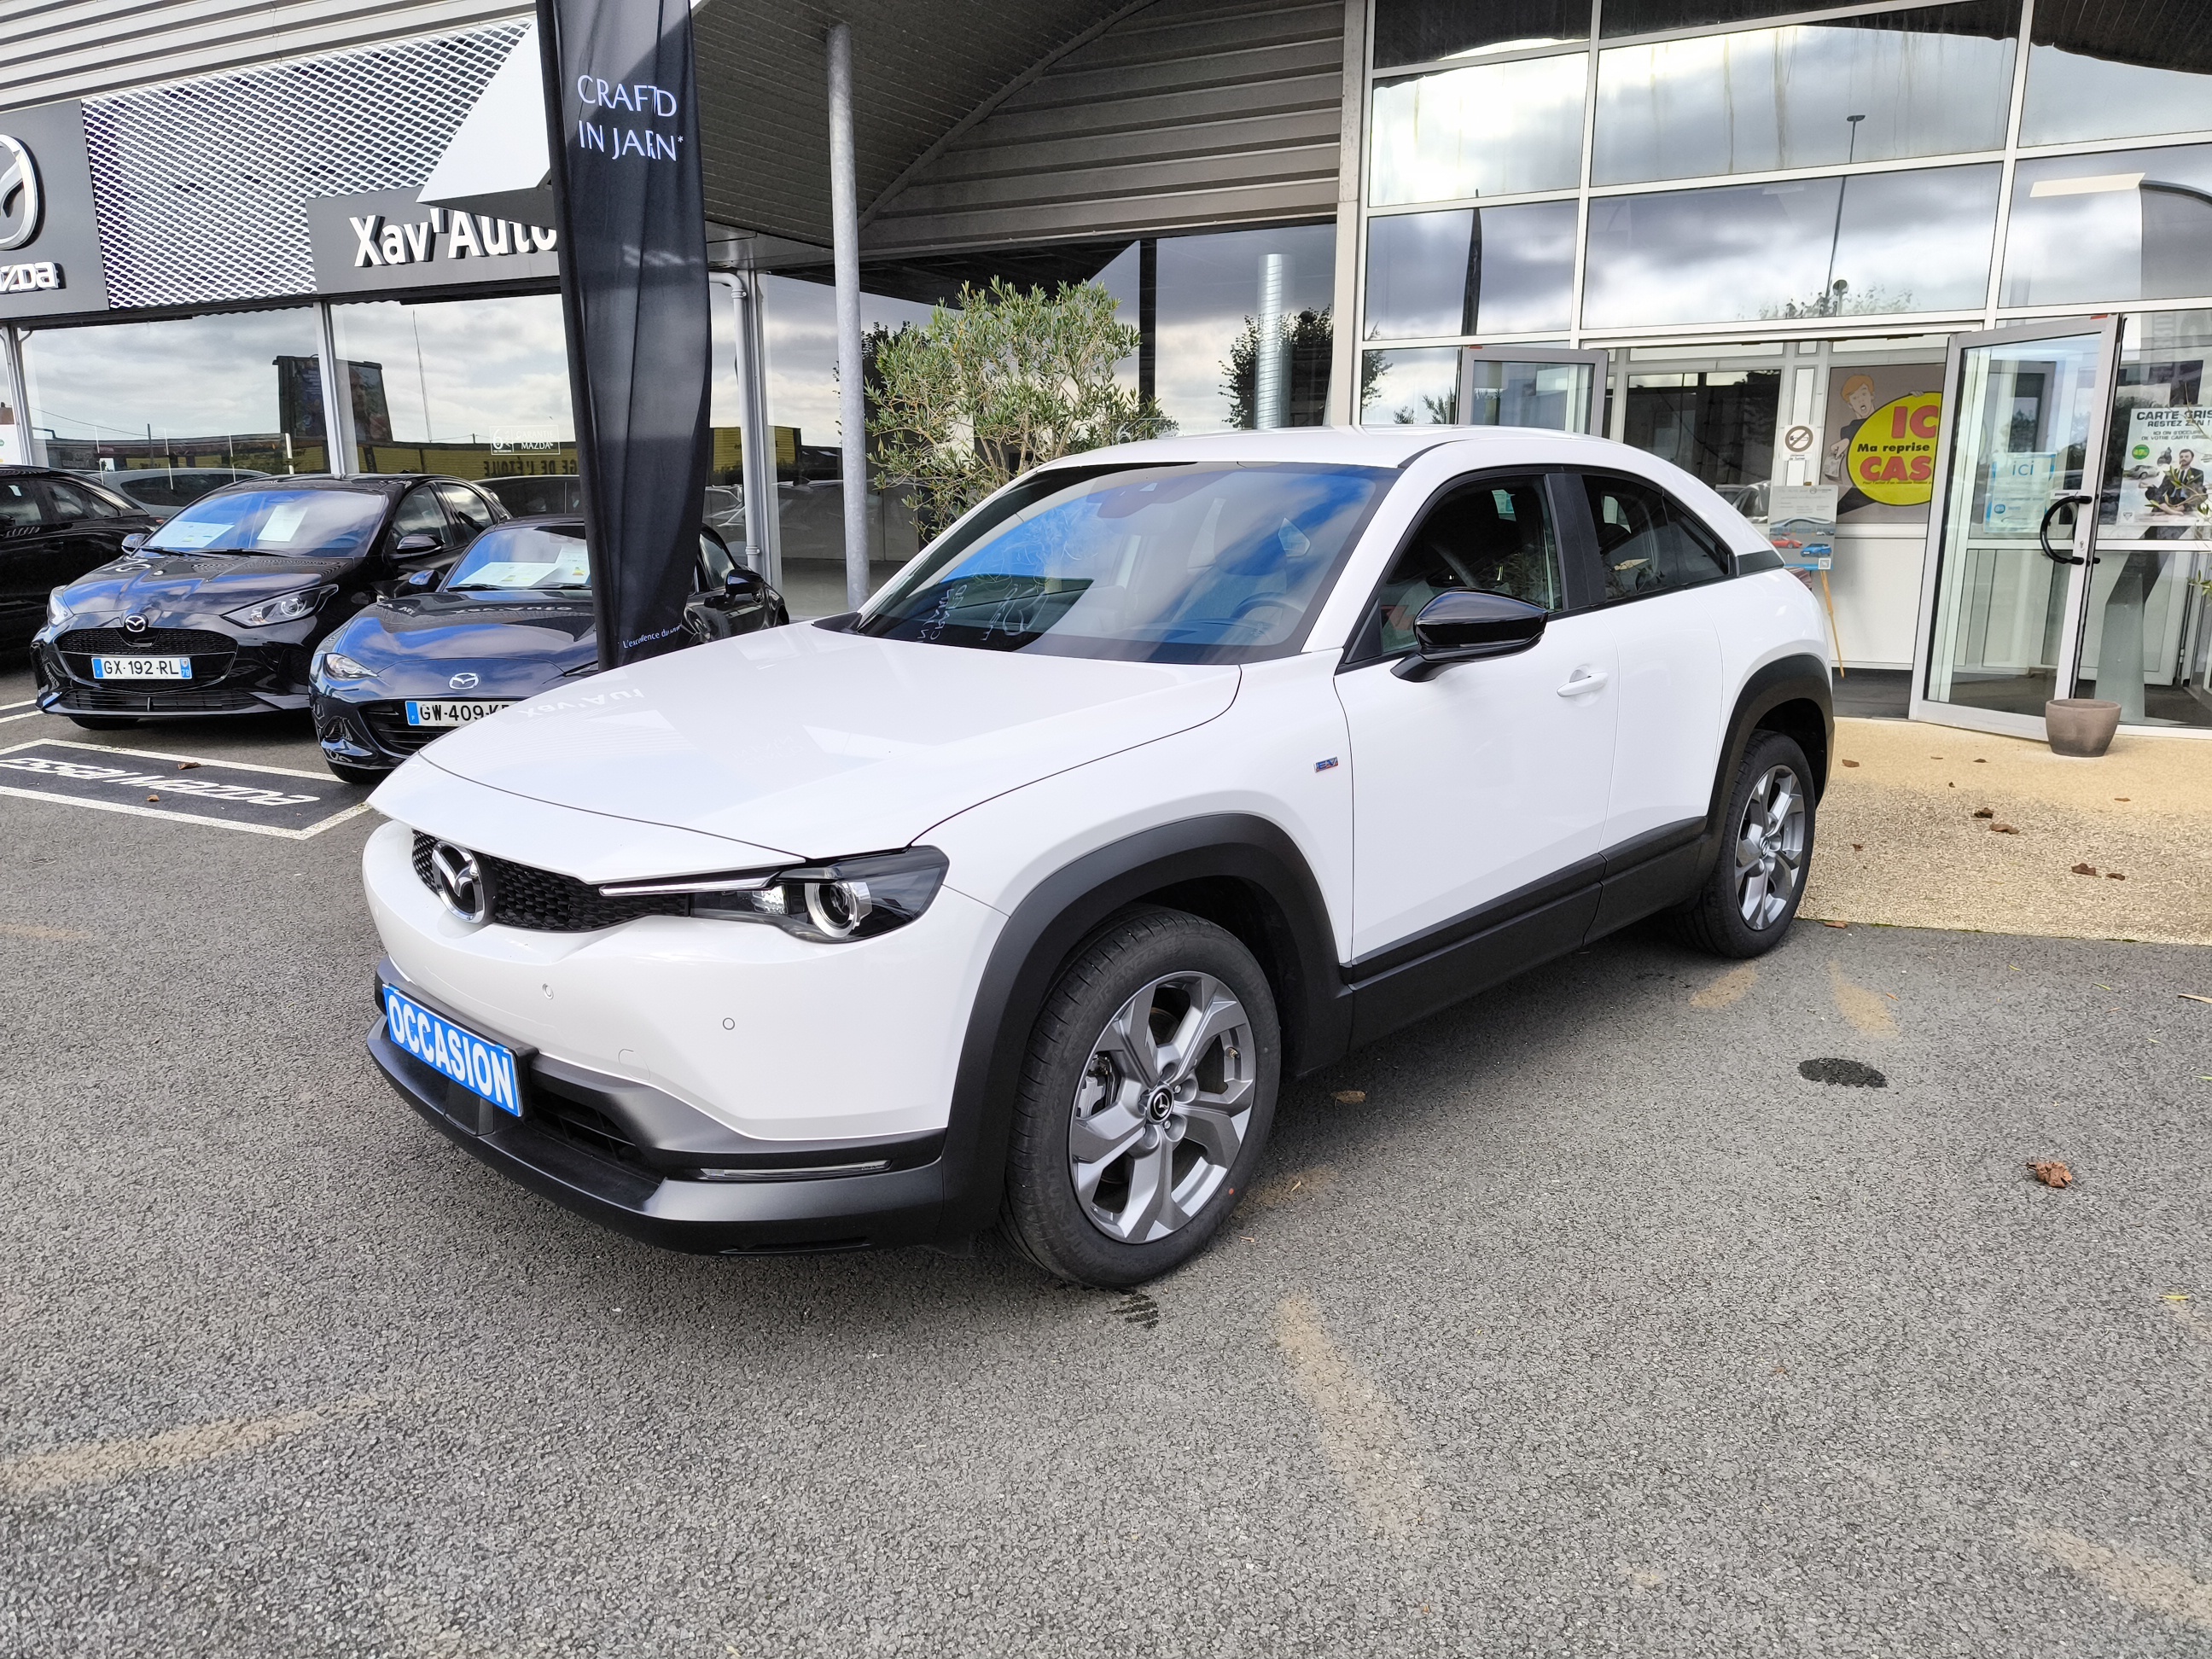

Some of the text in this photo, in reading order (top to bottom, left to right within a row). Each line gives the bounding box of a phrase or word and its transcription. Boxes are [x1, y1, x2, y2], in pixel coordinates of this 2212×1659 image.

[579, 119, 605, 153] IN
[2136, 411, 2179, 421] CARTE
[521, 441, 551, 450] MAZDA
[1857, 442, 1930, 453] Ma reprise
[2012, 461, 2034, 475] ici
[1317, 757, 1338, 770] EV
[388, 995, 514, 1109] OCCASION
